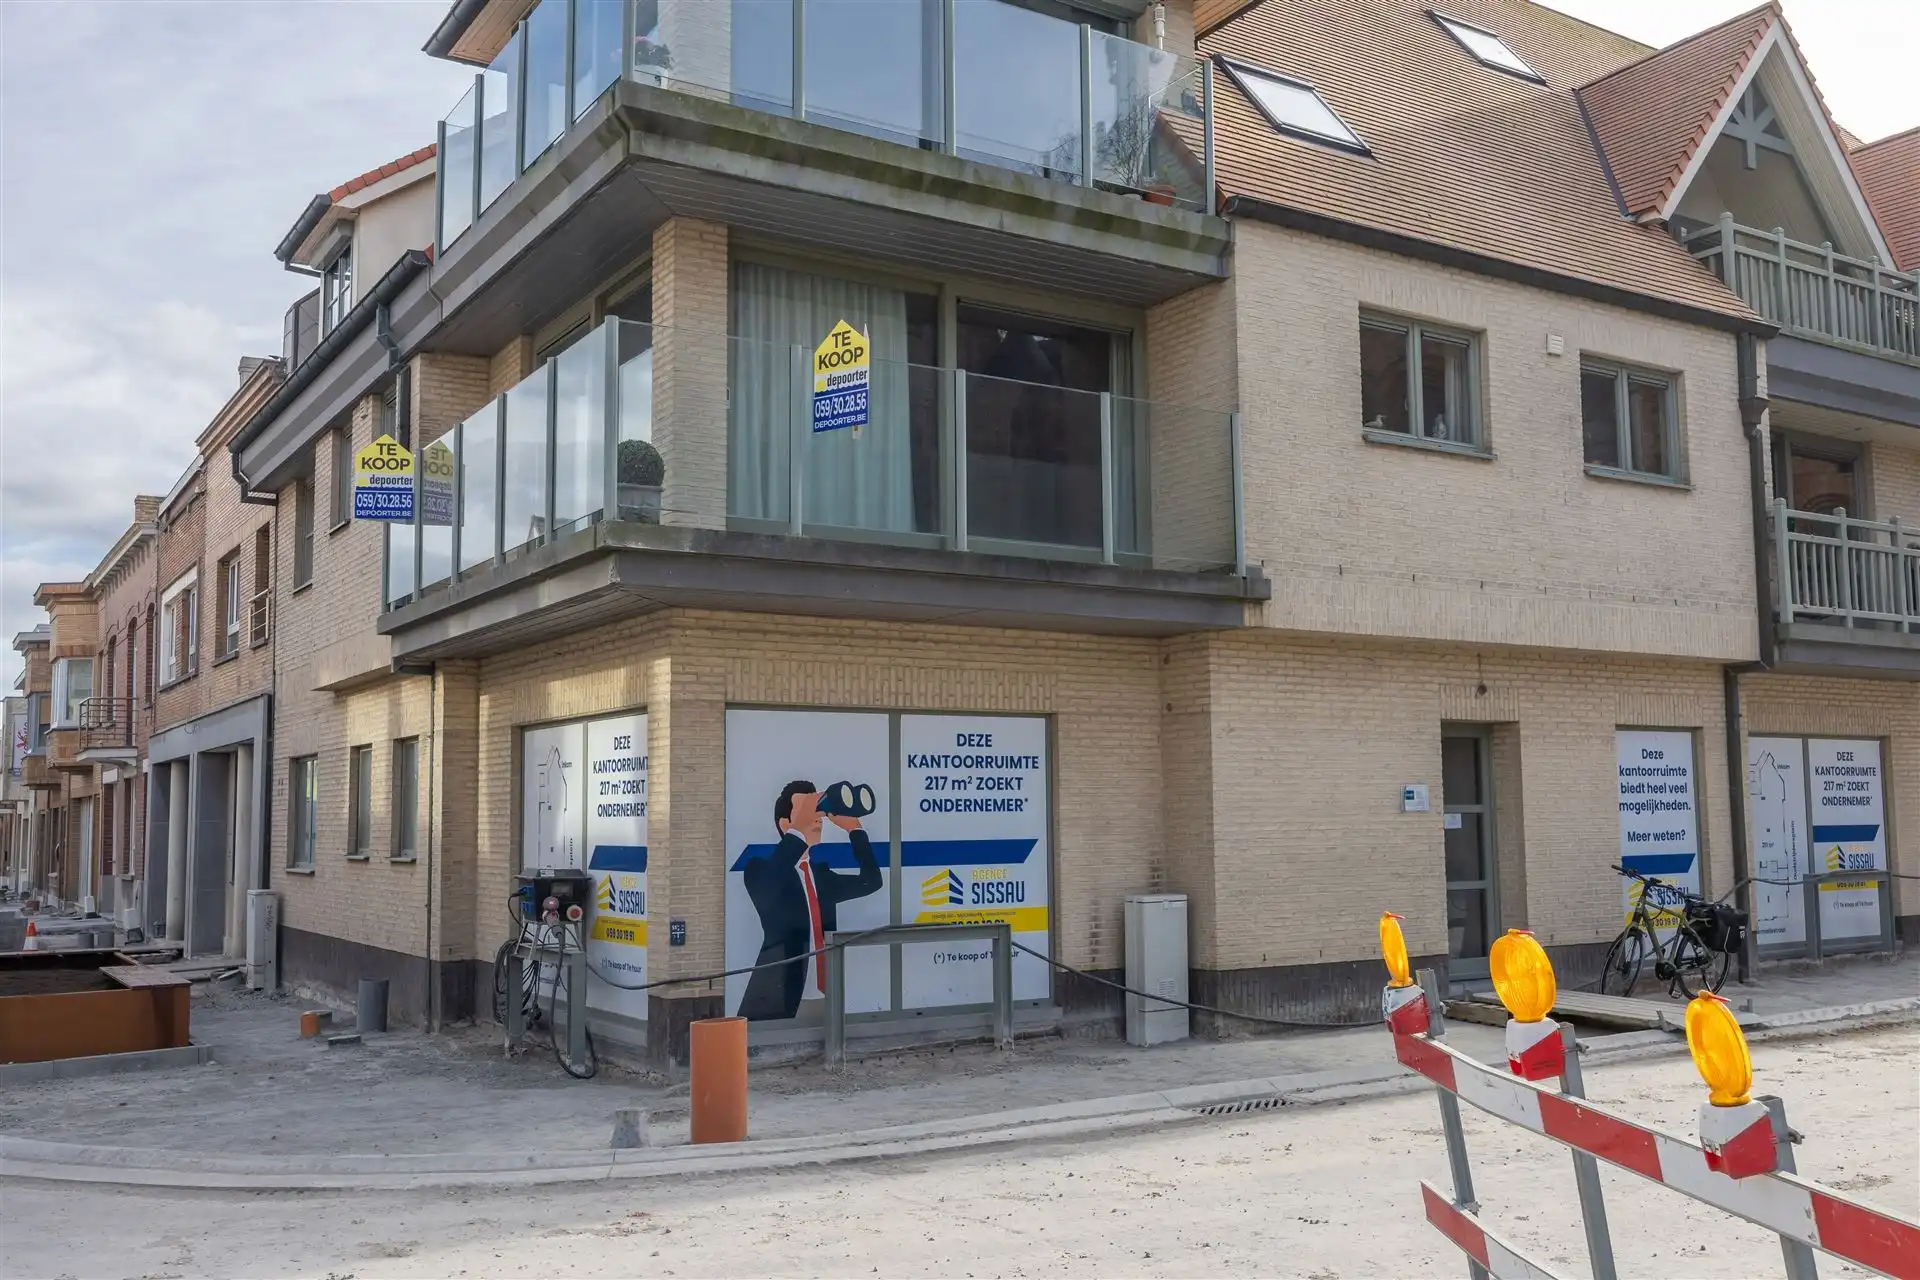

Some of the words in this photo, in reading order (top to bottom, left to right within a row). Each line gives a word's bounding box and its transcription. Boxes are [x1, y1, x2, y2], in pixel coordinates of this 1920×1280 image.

[832, 330, 852, 348] TE
[818, 346, 864, 370] KOOP
[827, 370, 868, 388] depoorter
[815, 392, 867, 418] 059/30.28.56
[814, 413, 867, 429] DEPOORTER.BE
[376, 443, 397, 456] TE
[361, 457, 410, 470] KOOP
[369, 474, 413, 487] depoorter
[356, 493, 412, 509] 059/30.28.56
[614, 736, 631, 750] DEZE
[957, 733, 993, 747] DEZE
[907, 754, 1040, 769] KANTOORRUIMTE
[1641, 748, 1664, 760] Deze
[1836, 751, 1854, 761] DEZE
[593, 756, 648, 774] KANTOORRUIMT
[1619, 765, 1688, 777] kantoorruimte
[1815, 766, 1877, 777] KANTOORRUIMTE
[600, 781, 610, 796] 217
[622, 779, 645, 794] ZOEKT
[924, 775, 948, 791] 217
[951, 775, 972, 791] m²
[976, 776, 1024, 791] ZOEKT
[1620, 781, 1645, 793] biedt
[1646, 782, 1667, 793] heel
[1668, 782, 1688, 793] veel
[1824, 781, 1835, 791] 217
[1847, 781, 1870, 791] ZOEKT
[1618, 798, 1691, 815] mogelijkheden.
[1627, 831, 1651, 842] Meer
[1652, 829, 1686, 841] weten?
[1848, 852, 1875, 869] SISSAU
[971, 881, 1025, 904] SISSAU
[618, 890, 645, 915] SISSAU
[947, 953, 957, 962] Te
[958, 952, 979, 962] koop
[980, 951, 988, 960] of
